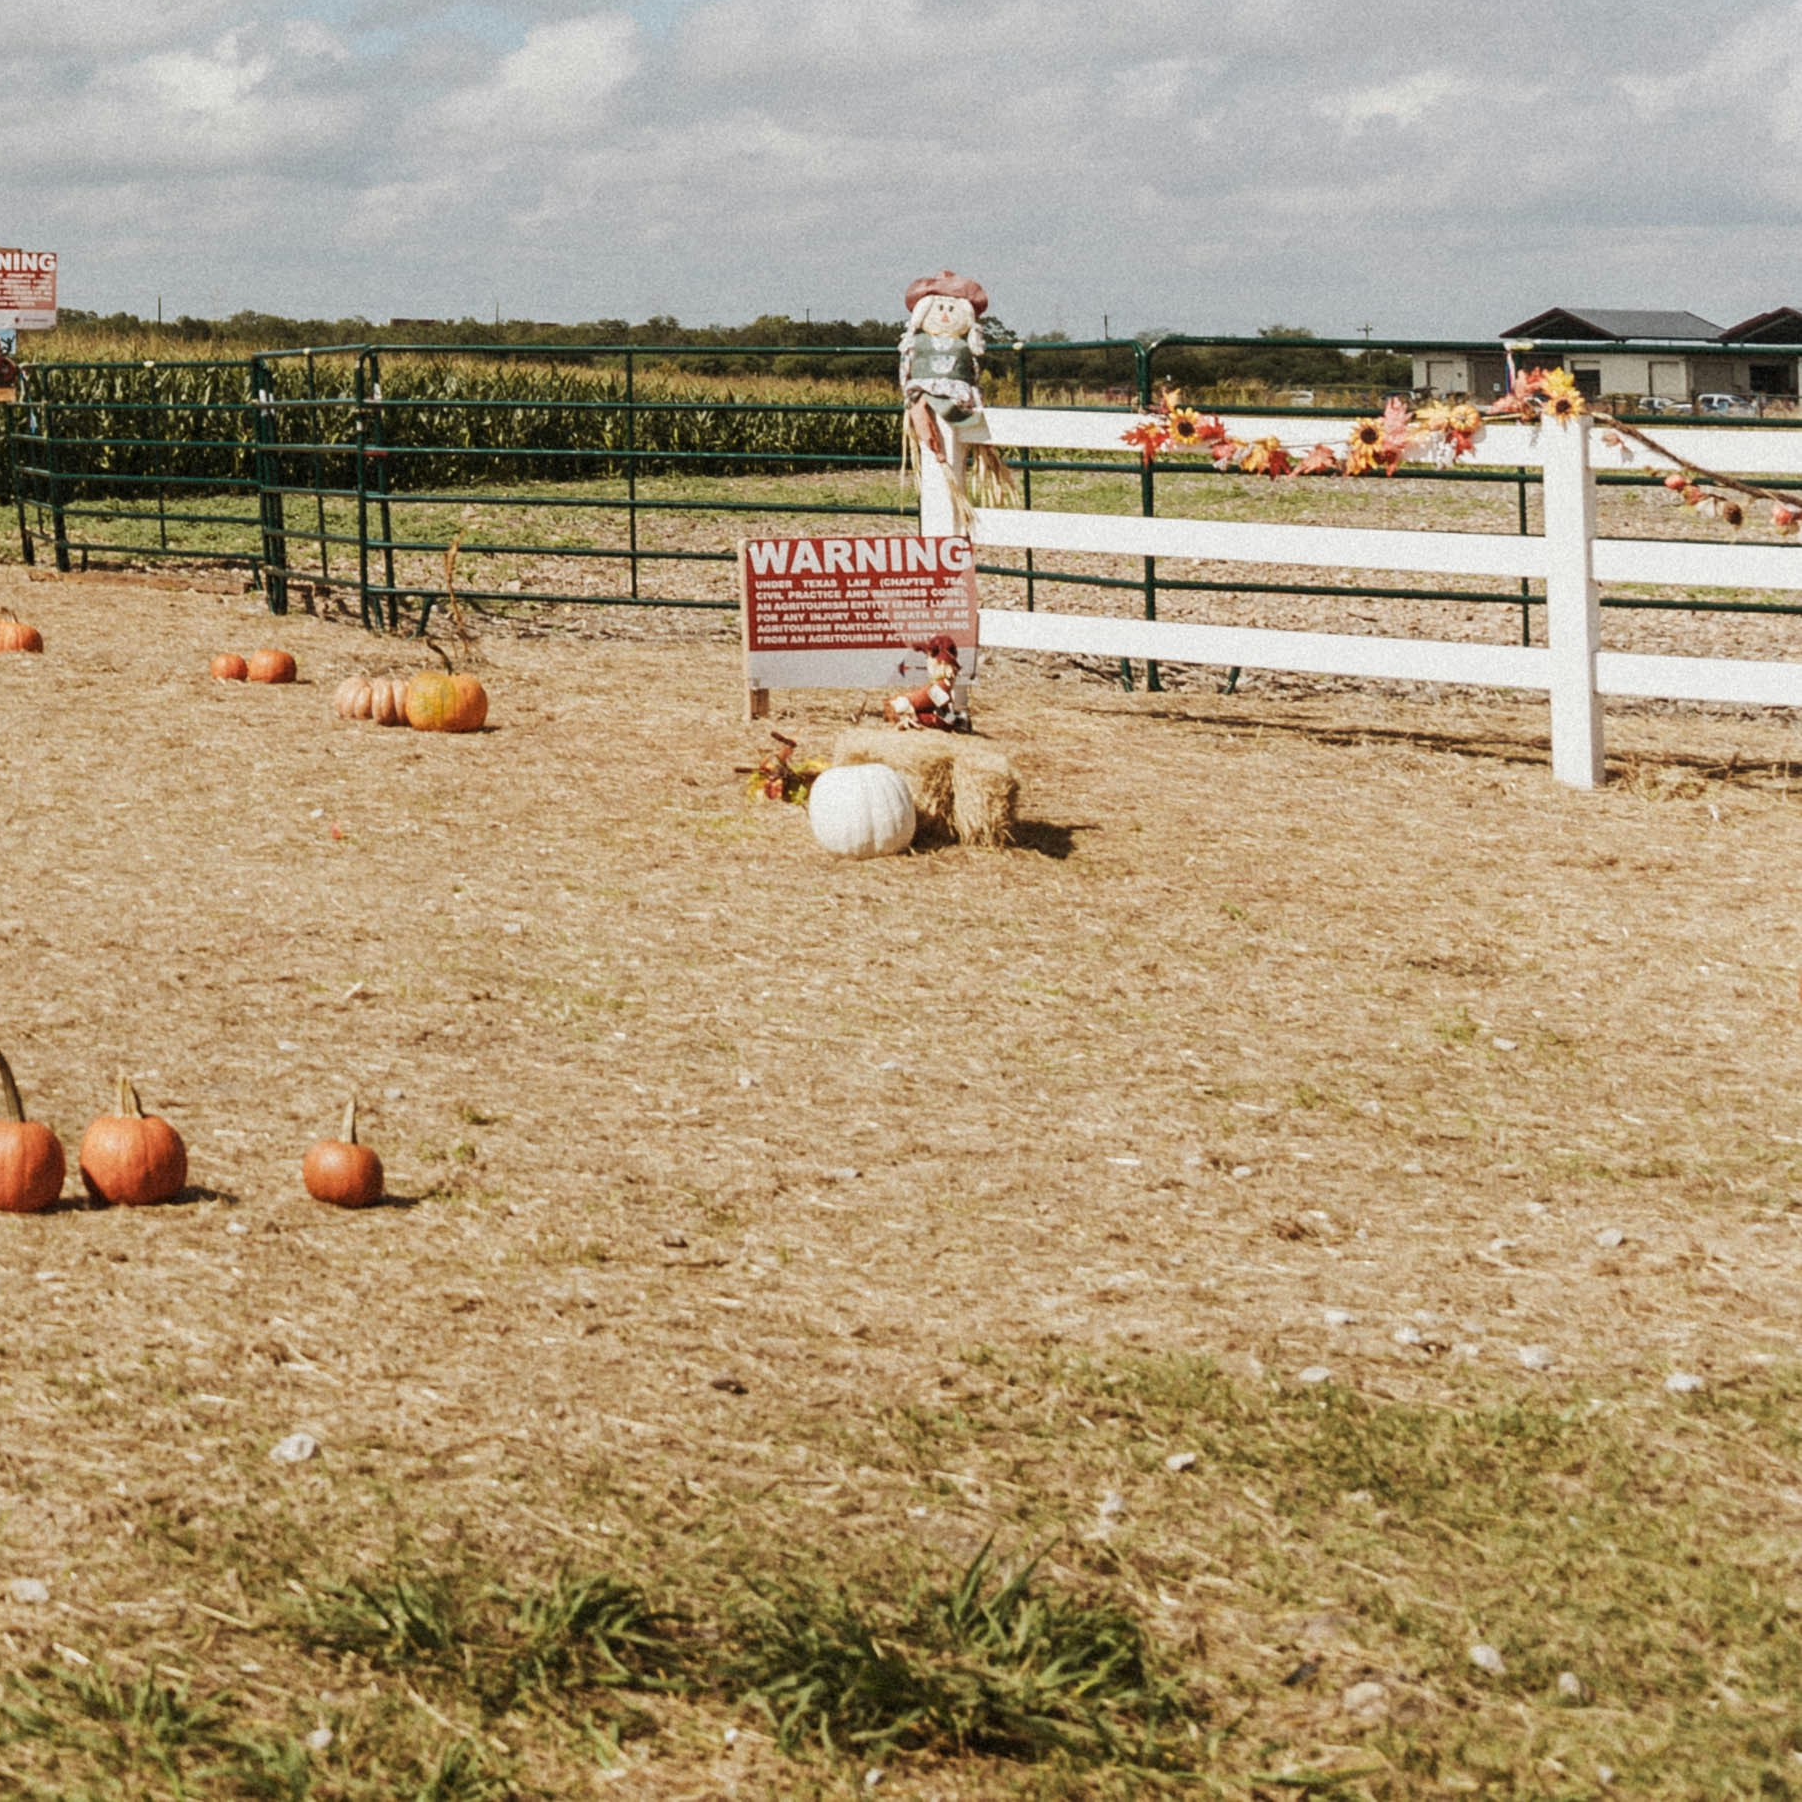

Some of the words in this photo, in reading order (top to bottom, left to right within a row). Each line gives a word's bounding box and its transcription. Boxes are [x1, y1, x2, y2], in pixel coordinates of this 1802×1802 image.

[748, 537, 973, 575] WARNING
[755, 580, 793, 589] UNDER
[801, 579, 838, 588] TEXAS
[846, 578, 871, 587] LAW
[879, 577, 934, 589] (CHAPTER
[787, 590, 842, 599] PRACTICE
[845, 589, 869, 599] AND
[756, 602, 771, 611] AN
[773, 601, 849, 611] AGRITOURISM
[850, 600, 889, 610] ENTITY
[904, 599, 927, 608] NOT
[756, 613, 778, 622] FOR
[782, 613, 805, 622] ANY
[809, 612, 850, 621] INJURY
[854, 612, 869, 620] TO
[873, 611, 889, 620] OR
[893, 610, 929, 620] DEATH
[934, 610, 948, 619] OF
[953, 609, 969, 618] AN
[757, 624, 832, 633] AGRITOURISM
[834, 622, 903, 631] PARTICIPANT
[907, 621, 969, 630] RESULTING
[757, 635, 787, 645] FROM
[790, 635, 806, 643] AN
[808, 634, 883, 643] AGRITOURISM
